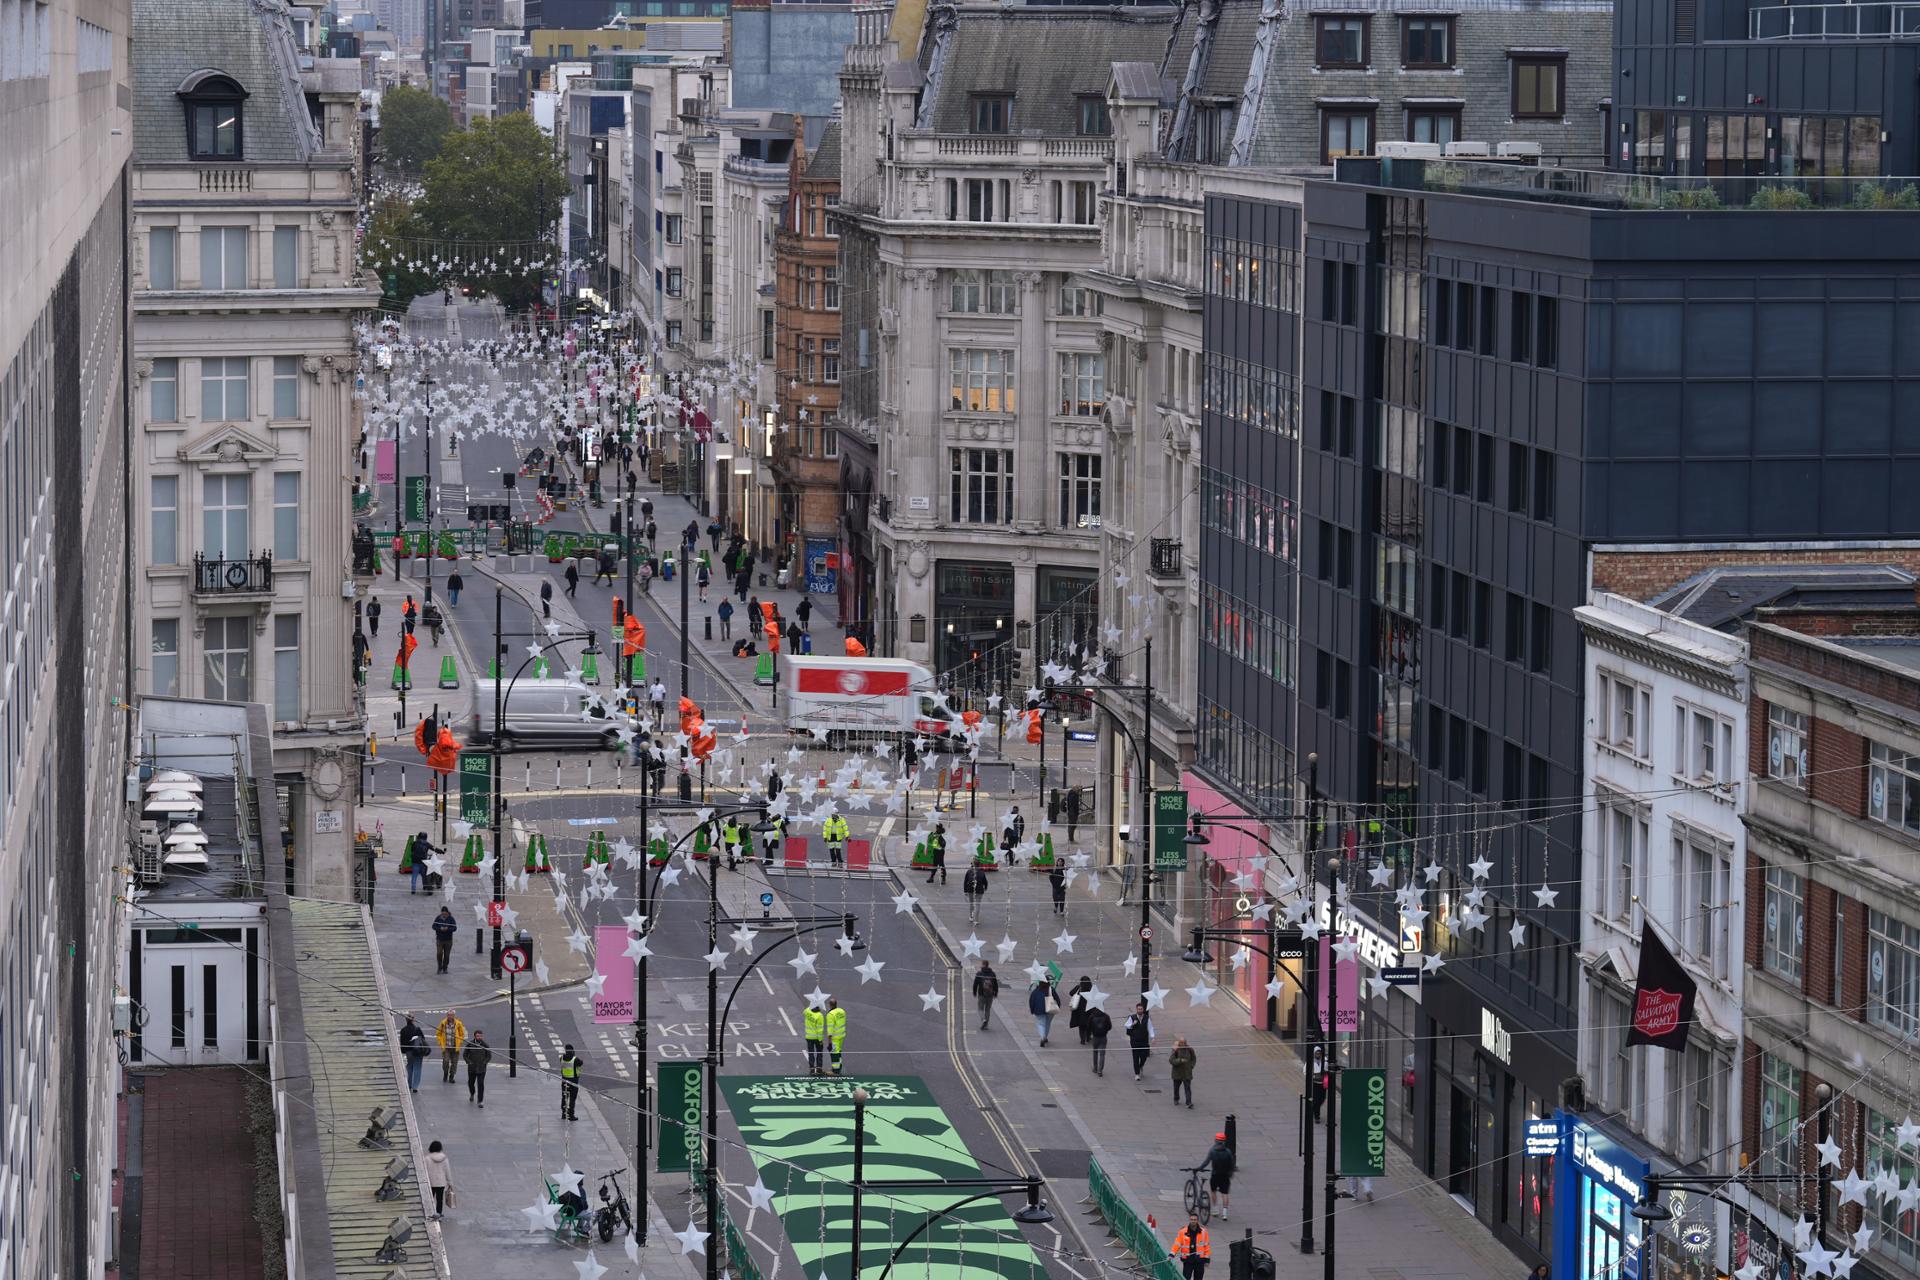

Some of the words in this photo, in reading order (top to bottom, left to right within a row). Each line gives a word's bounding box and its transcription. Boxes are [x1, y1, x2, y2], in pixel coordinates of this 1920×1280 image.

[1281, 950, 1302, 958] ecco
[595, 1001, 625, 1009] MAYOR
[1646, 994, 1662, 1006] THE
[595, 1009, 633, 1017] LONDON
[1635, 1000, 1678, 1023] SALVATION
[1647, 1014, 1673, 1030] ARMY
[1496, 1017, 1511, 1066] Store
[754, 1092, 904, 1100] WLCOME
[684, 1068, 701, 1150] OXFORD
[1367, 1075, 1385, 1155] OXFORD
[1529, 1122, 1558, 1134] atm
[1526, 1137, 1560, 1147] Change
[1527, 1146, 1558, 1155] Money
[1586, 1146, 1614, 1182] Change
[1614, 1165, 1640, 1203] Money
